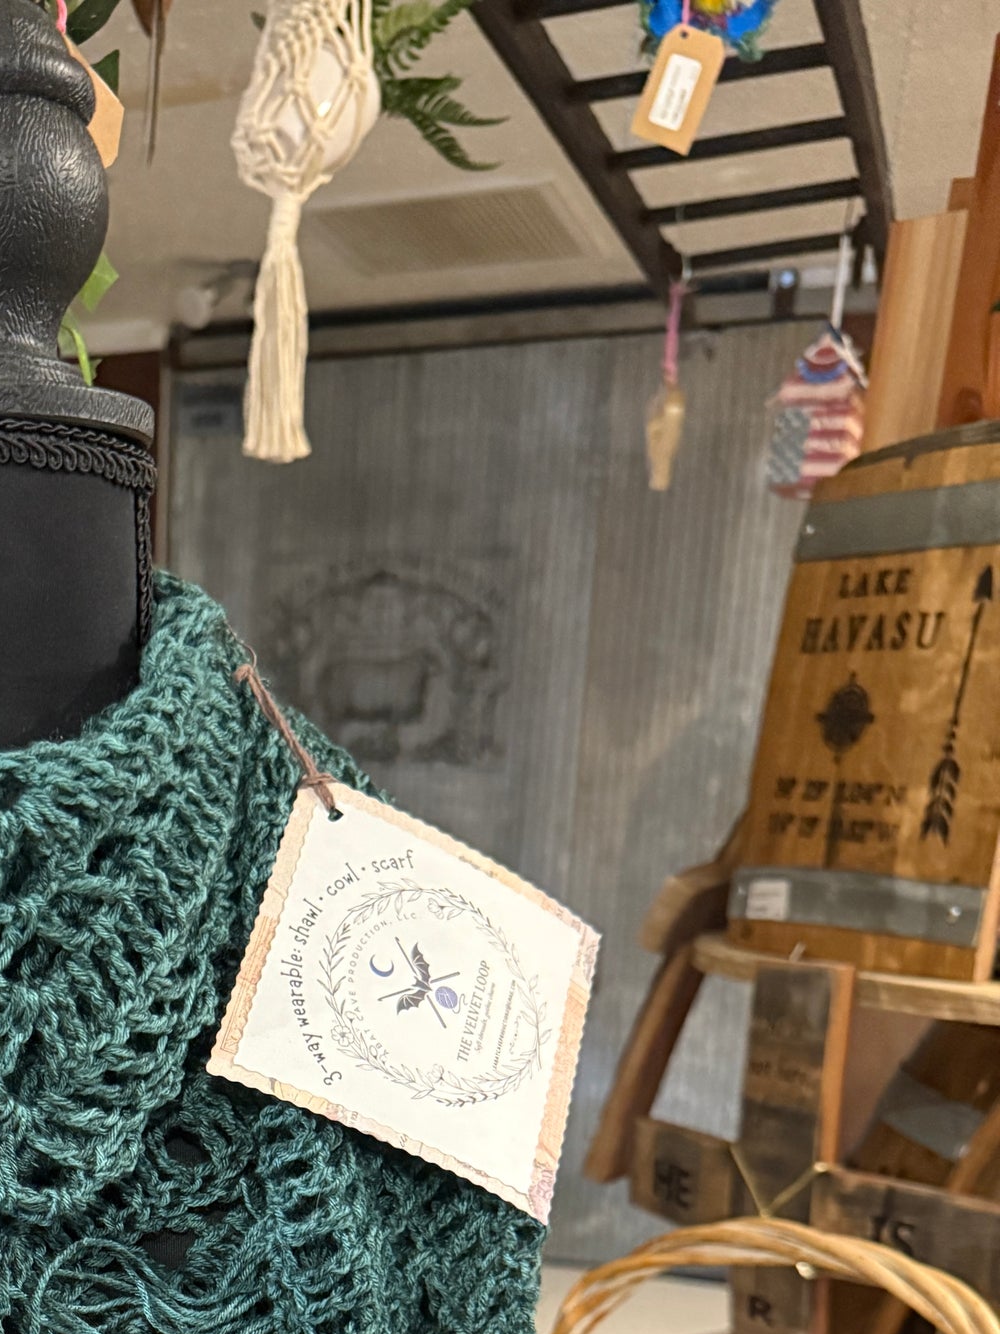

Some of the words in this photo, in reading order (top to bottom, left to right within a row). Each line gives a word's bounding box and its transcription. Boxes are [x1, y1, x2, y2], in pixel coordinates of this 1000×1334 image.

[838, 567, 912, 599] LAKE
[801, 610, 946, 654] HAVASU
[326, 862, 360, 897] cowl
[371, 849, 414, 873] scarf
[289, 898, 324, 946] shawl
[280, 949, 310, 1028] wearable:
[474, 960, 491, 993] LOOP
[463, 992, 483, 1036] VELVET
[303, 1032, 343, 1086] 3-way
[456, 1036, 474, 1062] THE
